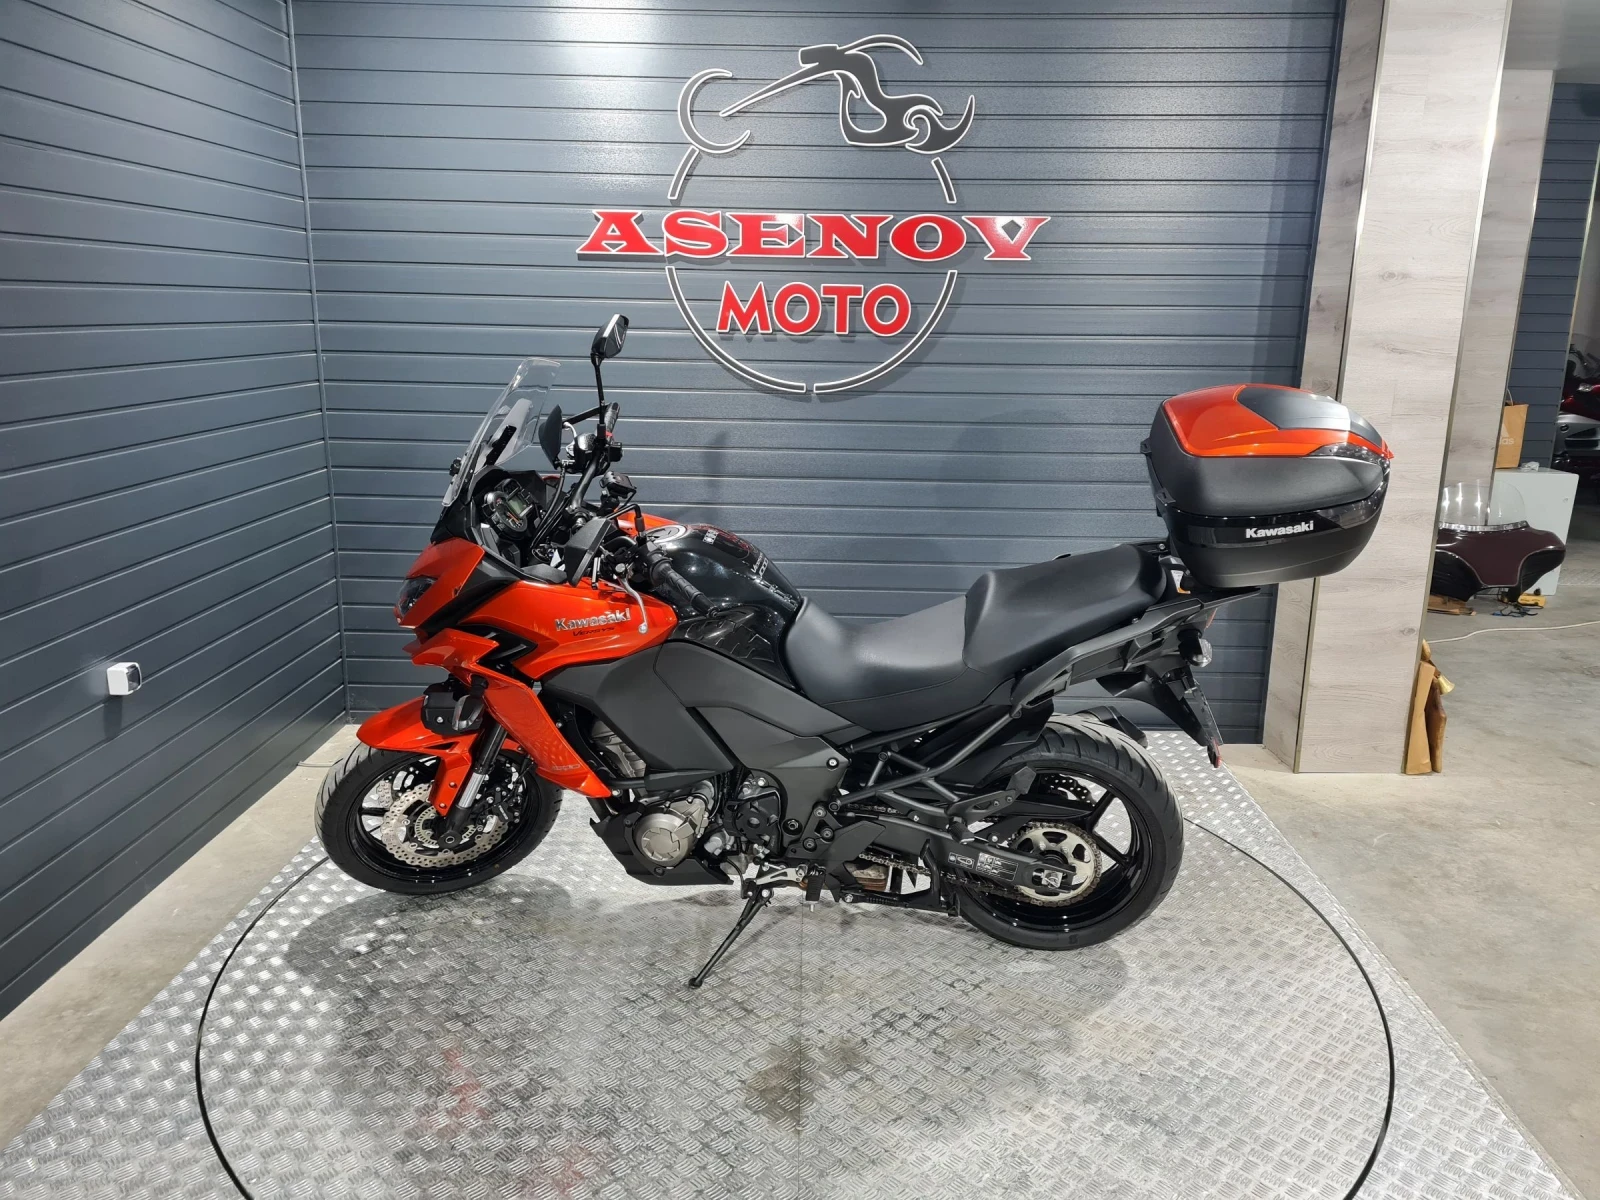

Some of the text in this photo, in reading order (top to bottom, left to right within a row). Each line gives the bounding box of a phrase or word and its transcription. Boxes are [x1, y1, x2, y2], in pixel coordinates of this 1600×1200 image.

[576, 209, 1051, 262] ASENOV
[716, 281, 913, 337] MOTO
[1245, 520, 1314, 539] Kawasaki
[554, 608, 632, 632] Kawasaki
